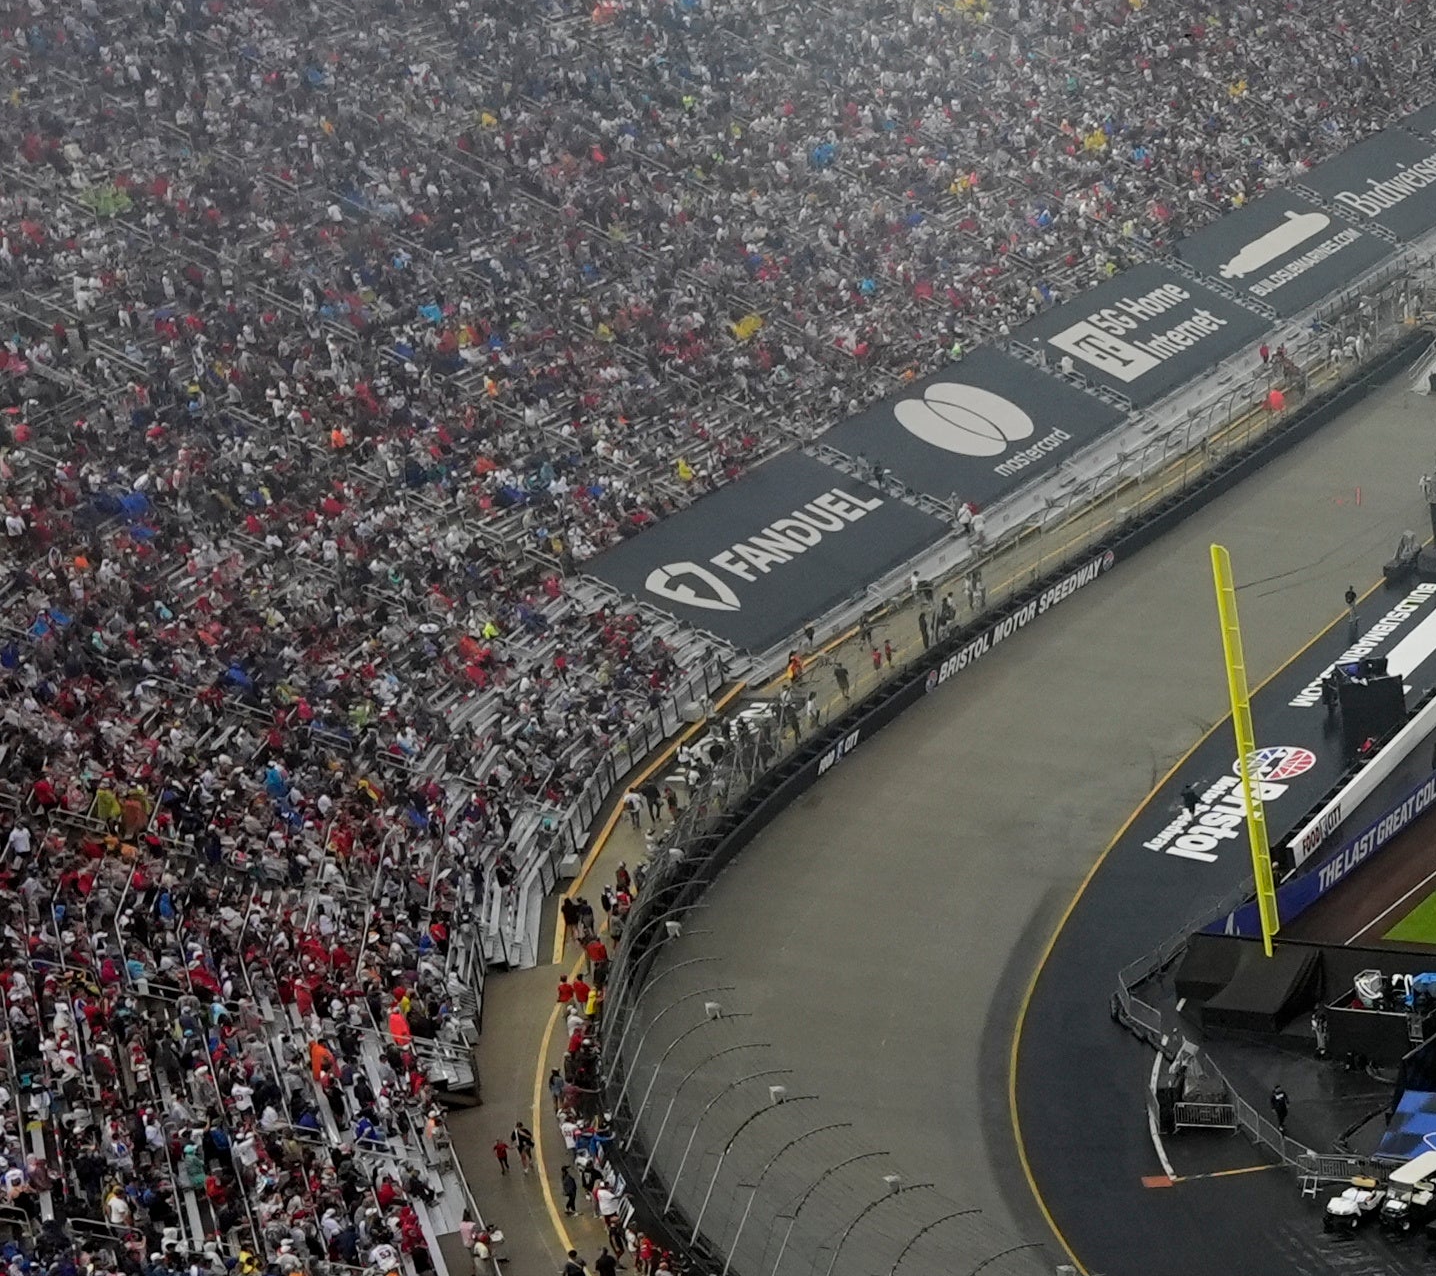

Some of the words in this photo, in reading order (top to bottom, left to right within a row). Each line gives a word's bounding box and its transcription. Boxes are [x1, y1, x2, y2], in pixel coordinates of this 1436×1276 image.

[1248, 227, 1363, 297] BUILDSUBMARINES.COM
[1087, 308, 1139, 337] 5G
[1114, 281, 1191, 323] Home
[1132, 307, 1228, 361] Internet
[993, 426, 1075, 478] mastercard
[710, 487, 884, 582] FANDUEL
[938, 632, 991, 685] BRISTOL
[992, 600, 1038, 645] MOTOR
[1038, 557, 1102, 614] SPEEDWAY
[1165, 777, 1290, 863] Bristol
[1302, 826, 1322, 859] FOOD
[1327, 804, 1342, 835] CITY
[1318, 855, 1344, 893] THE
[1344, 830, 1377, 876] LAST
[1376, 797, 1418, 847] GREAT
